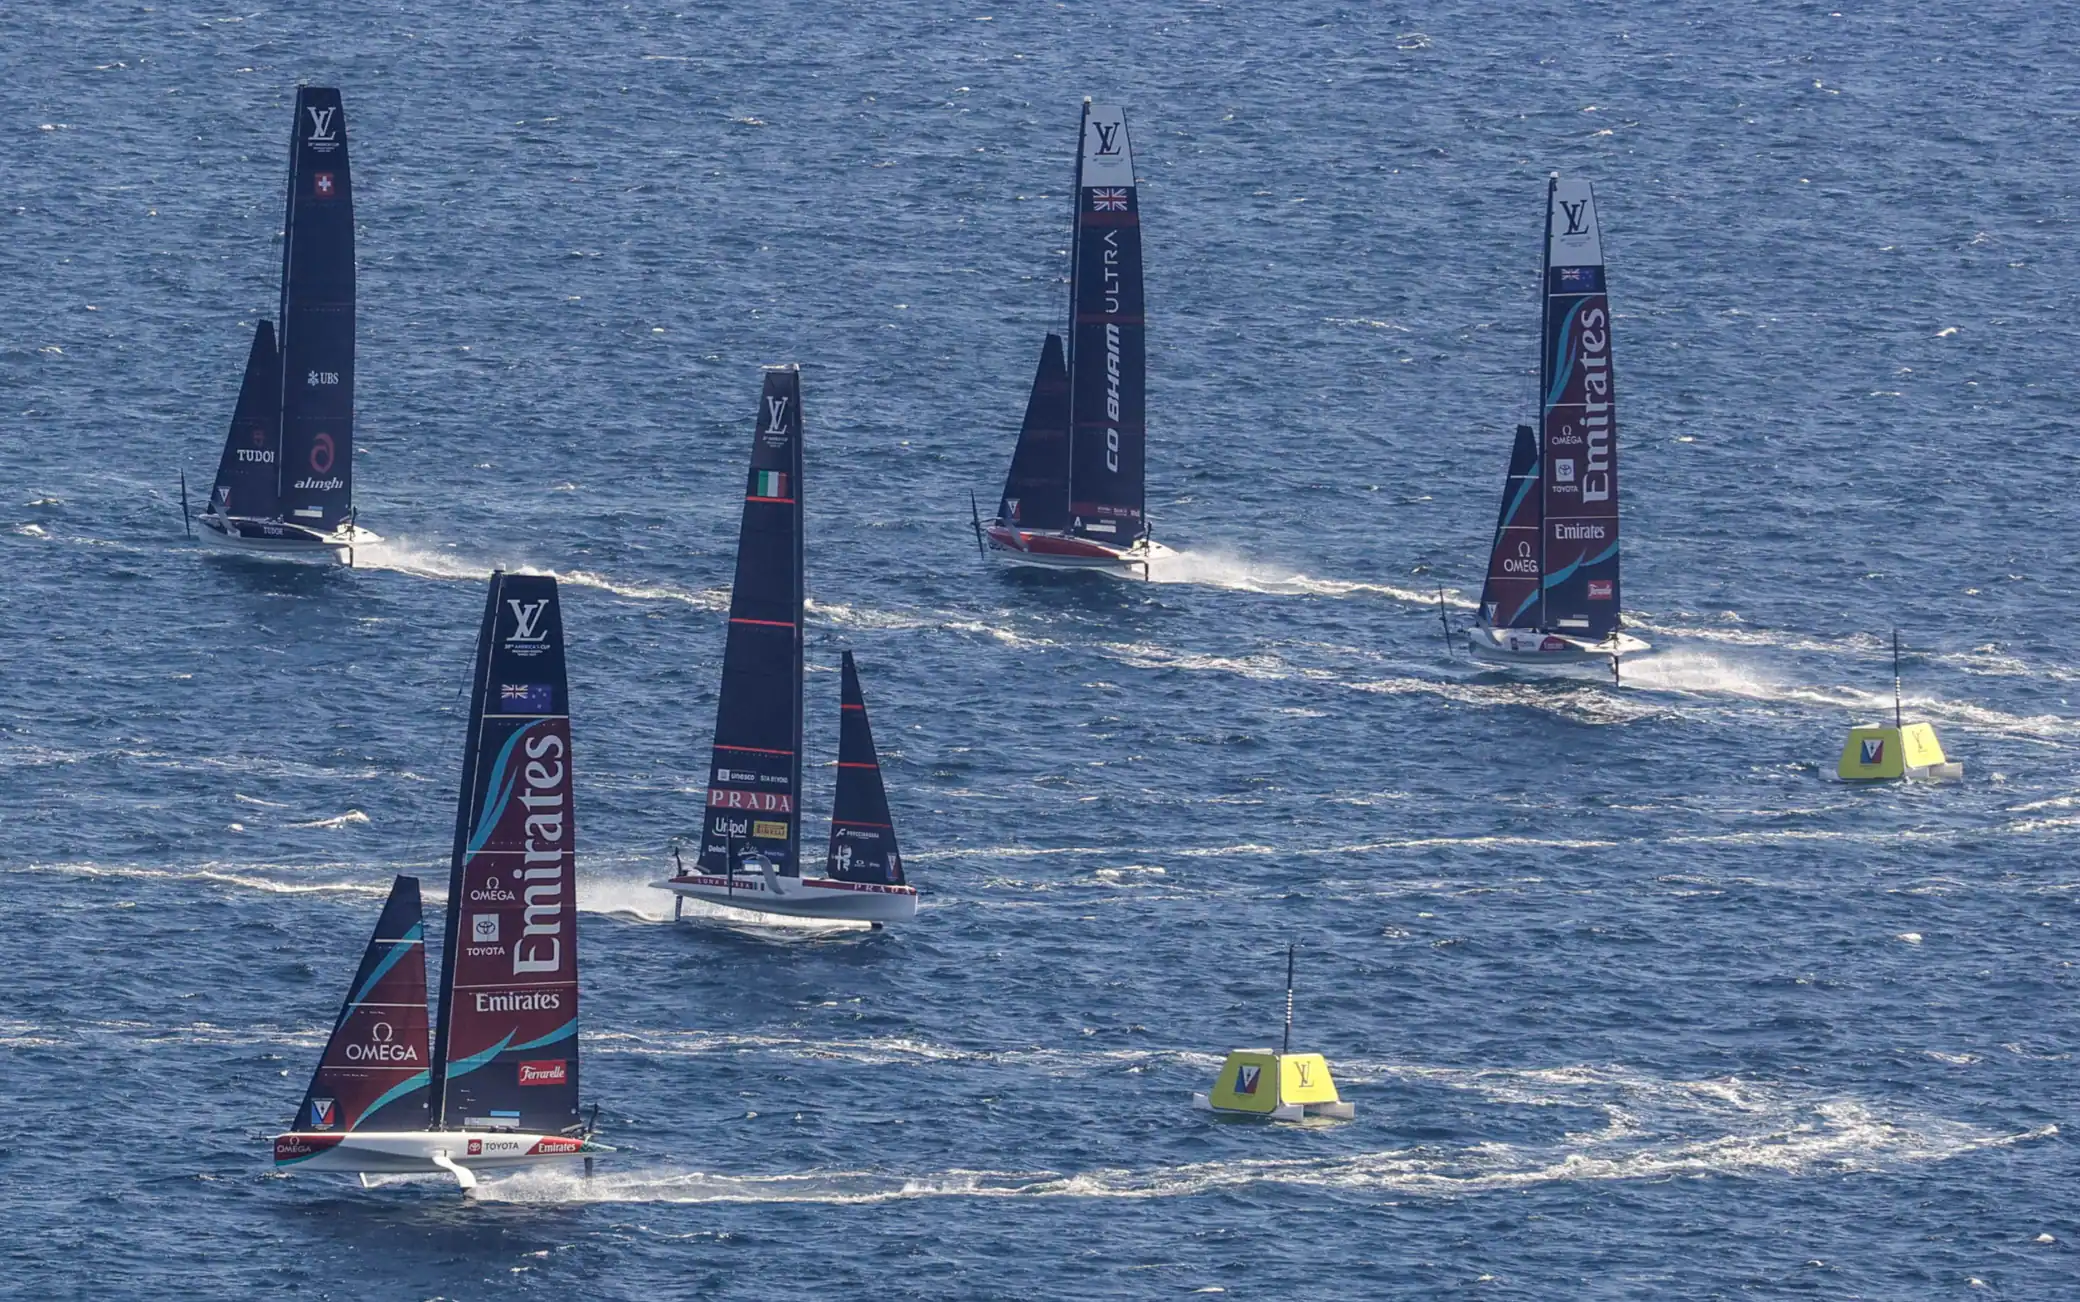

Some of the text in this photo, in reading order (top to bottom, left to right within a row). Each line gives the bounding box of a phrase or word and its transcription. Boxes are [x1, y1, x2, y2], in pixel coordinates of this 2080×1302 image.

[1104, 229, 1119, 313] ULTRA
[320, 372, 339, 385] UBS
[1580, 308, 1609, 504] Emirates
[1551, 435, 1583, 446] OMEGA
[294, 476, 344, 491] alinghi
[1552, 485, 1579, 493] TOYOTA
[1554, 522, 1605, 540] Emirates
[1503, 558, 1539, 573] OMEG
[731, 772, 755, 781] unesco
[711, 789, 790, 813] PRADA
[513, 734, 564, 976] Emirates
[470, 889, 516, 901] OMEGA
[467, 946, 506, 957] TOYOTA
[476, 991, 560, 1012] Emirates
[346, 1043, 418, 1061] OMEGA
[520, 1065, 565, 1082] Ferrarelle
[276, 1144, 312, 1153] OMEGA
[485, 1139, 519, 1150] TOYOTA
[538, 1142, 576, 1153] Emirates
